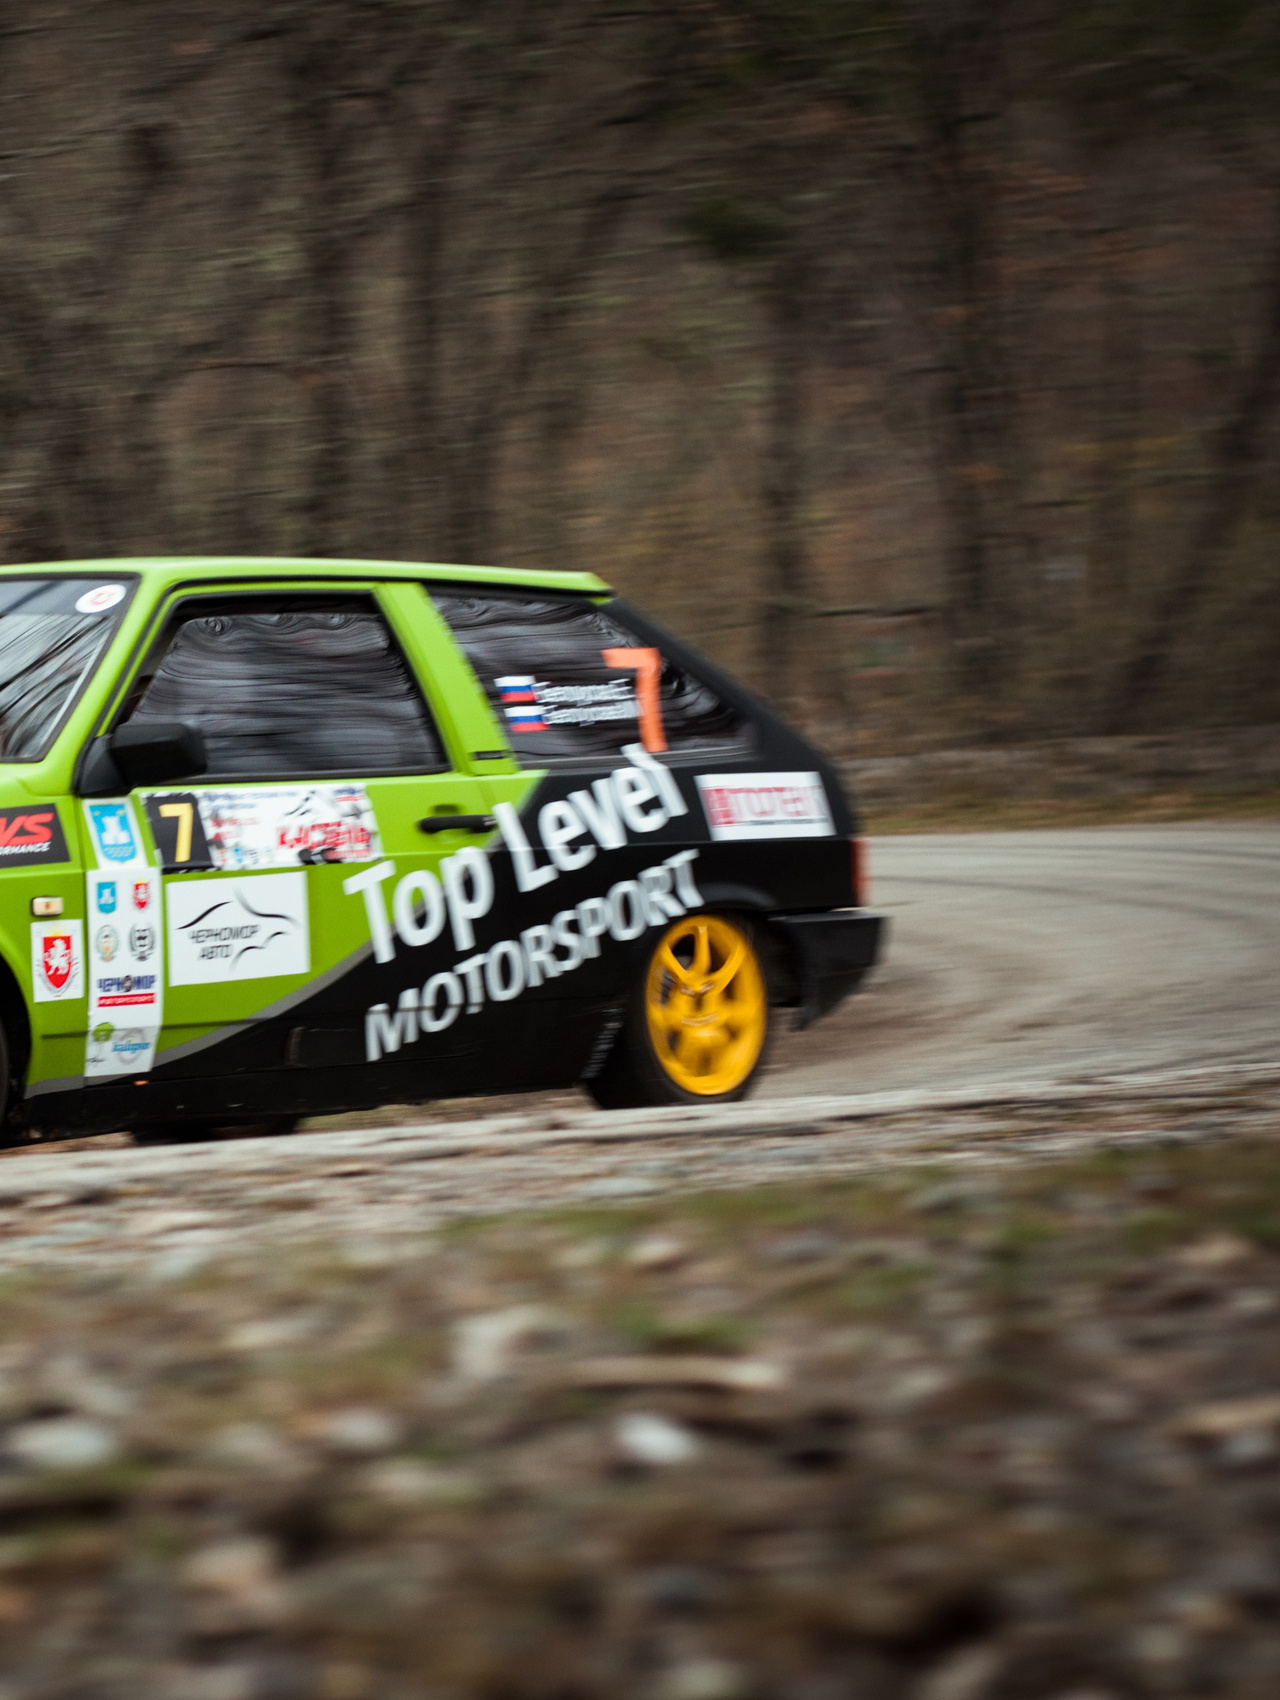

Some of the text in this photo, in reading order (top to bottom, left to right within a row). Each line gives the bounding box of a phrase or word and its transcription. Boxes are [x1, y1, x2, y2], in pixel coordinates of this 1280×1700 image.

[601, 647, 668, 753] 7
[158, 802, 194, 863] 7
[342, 742, 688, 964] Top Level
[364, 848, 705, 1062] MOTORSPORT
